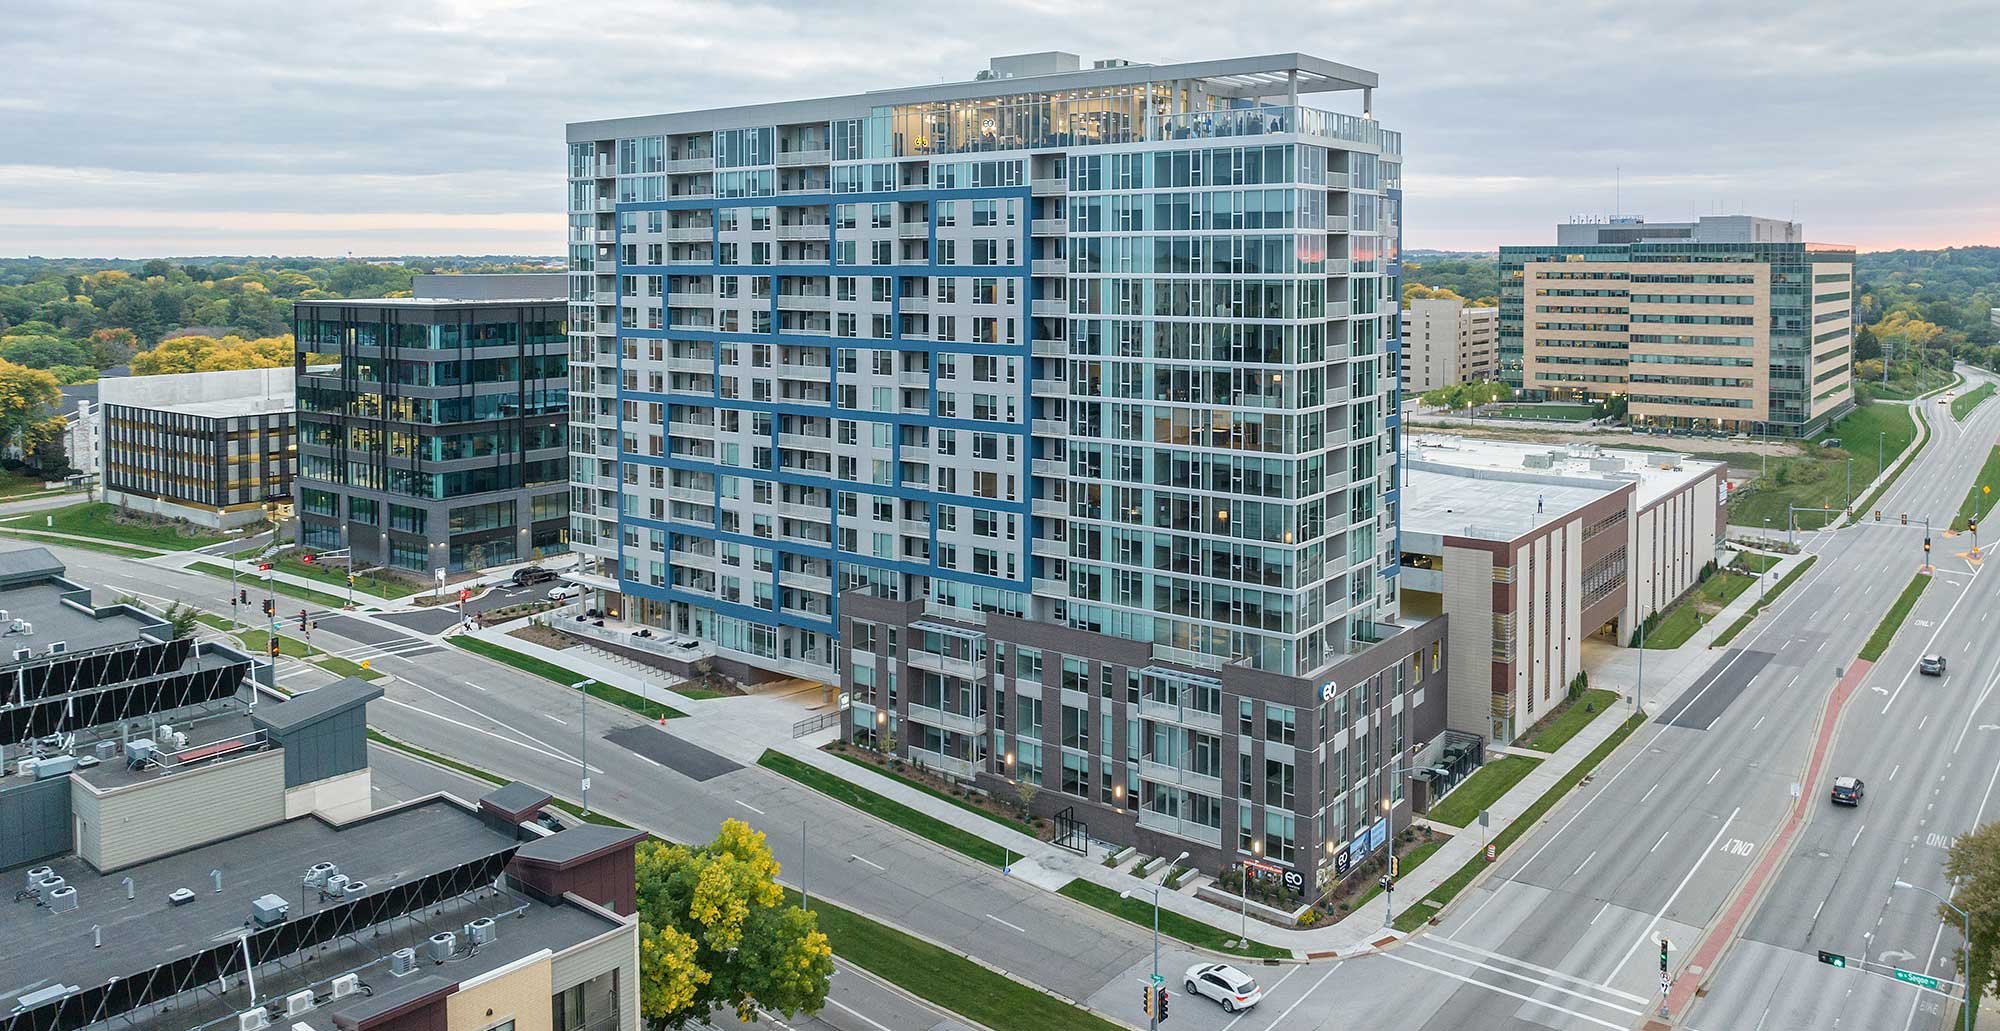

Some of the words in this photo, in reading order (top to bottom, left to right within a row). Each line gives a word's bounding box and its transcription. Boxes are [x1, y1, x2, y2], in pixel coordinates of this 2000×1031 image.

[1914, 619, 1935, 627] ONLY
[1323, 681, 1336, 700] eo
[1719, 838, 1755, 856] ONLY
[1338, 851, 1348, 866] eo
[1285, 871, 1302, 885] eo
[1908, 972, 1929, 985] Segoe
